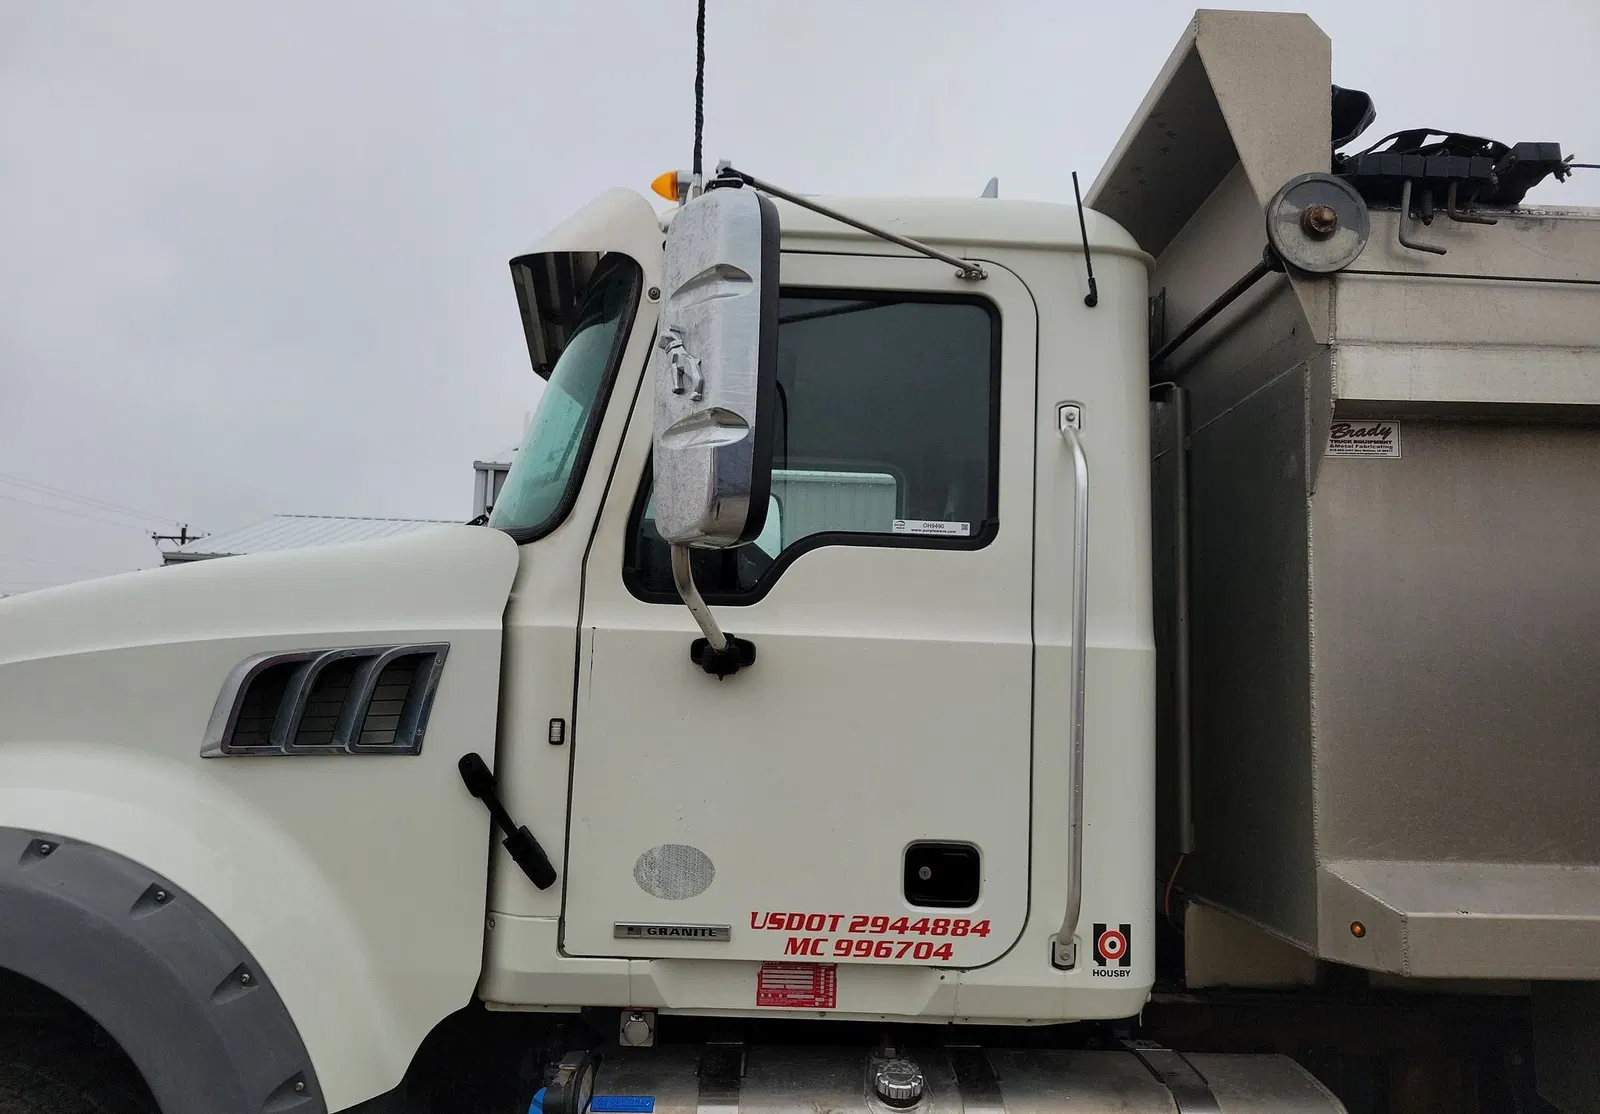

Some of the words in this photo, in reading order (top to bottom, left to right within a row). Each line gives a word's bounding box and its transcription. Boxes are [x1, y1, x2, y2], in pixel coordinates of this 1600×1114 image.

[1330, 423, 1392, 440] Brady
[647, 927, 717, 937] GRANITE
[750, 911, 844, 933] USDOT
[848, 915, 991, 938] 2944884
[784, 937, 828, 956] MC
[833, 939, 953, 961] 996704
[1092, 969, 1131, 977] HOUSBY
